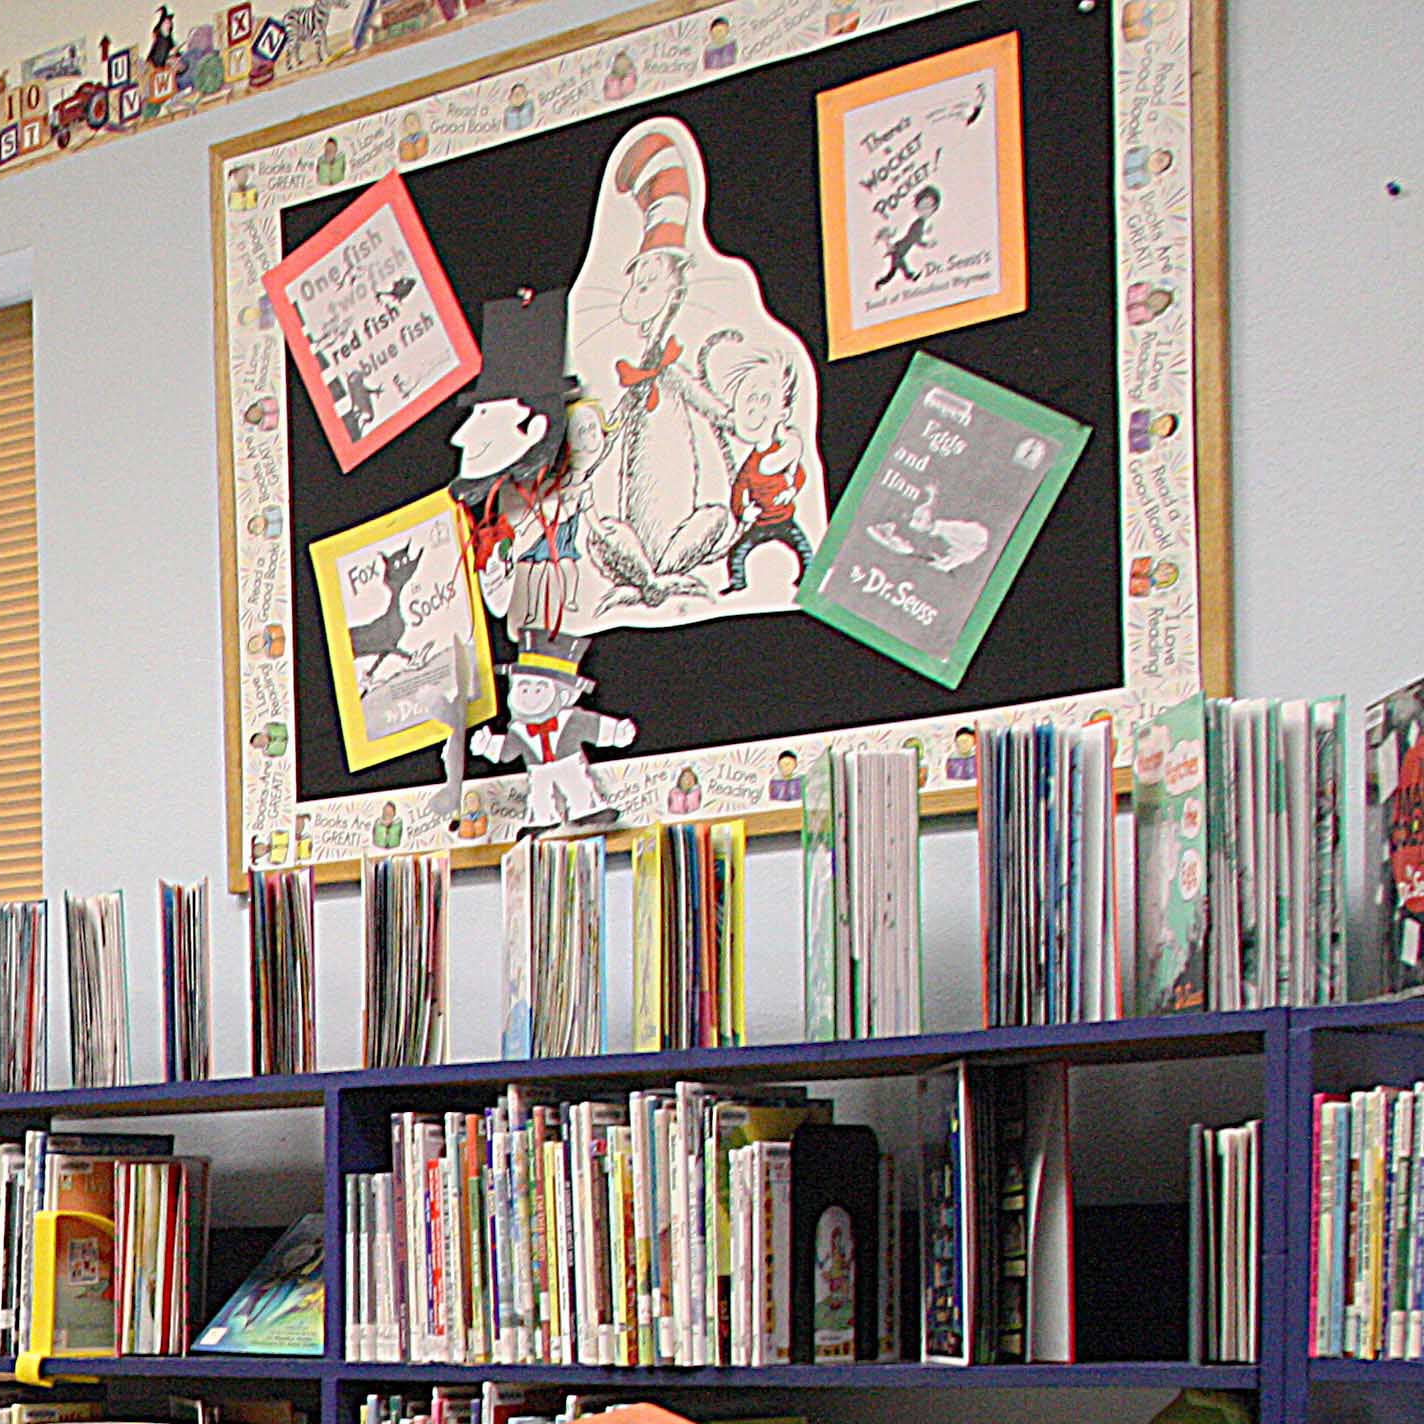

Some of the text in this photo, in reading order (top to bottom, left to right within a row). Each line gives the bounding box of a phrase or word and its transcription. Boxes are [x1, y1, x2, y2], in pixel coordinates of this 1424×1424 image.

[232, 12, 248, 35] X
[113, 58, 128, 80] U
[155, 74, 174, 97] W
[123, 93, 139, 115] V
[24, 124, 40, 147] T
[860, 131, 923, 191] WOCKET
[299, 228, 384, 301] One fish
[924, 258, 946, 278] Dr.
[331, 303, 402, 366] red fish
[352, 310, 436, 378] blue fish
[893, 444, 931, 472] and
[880, 468, 921, 502] Ham
[1128, 459, 1154, 504] Good
[1152, 464, 1176, 507] Read
[347, 560, 381, 596] Fox
[862, 566, 939, 627] Dr. Seuss
[408, 581, 457, 628] Socks
[1142, 607, 1164, 679] Reading!
[1163, 626, 1178, 667] Love
[315, 813, 372, 830] Books Are
